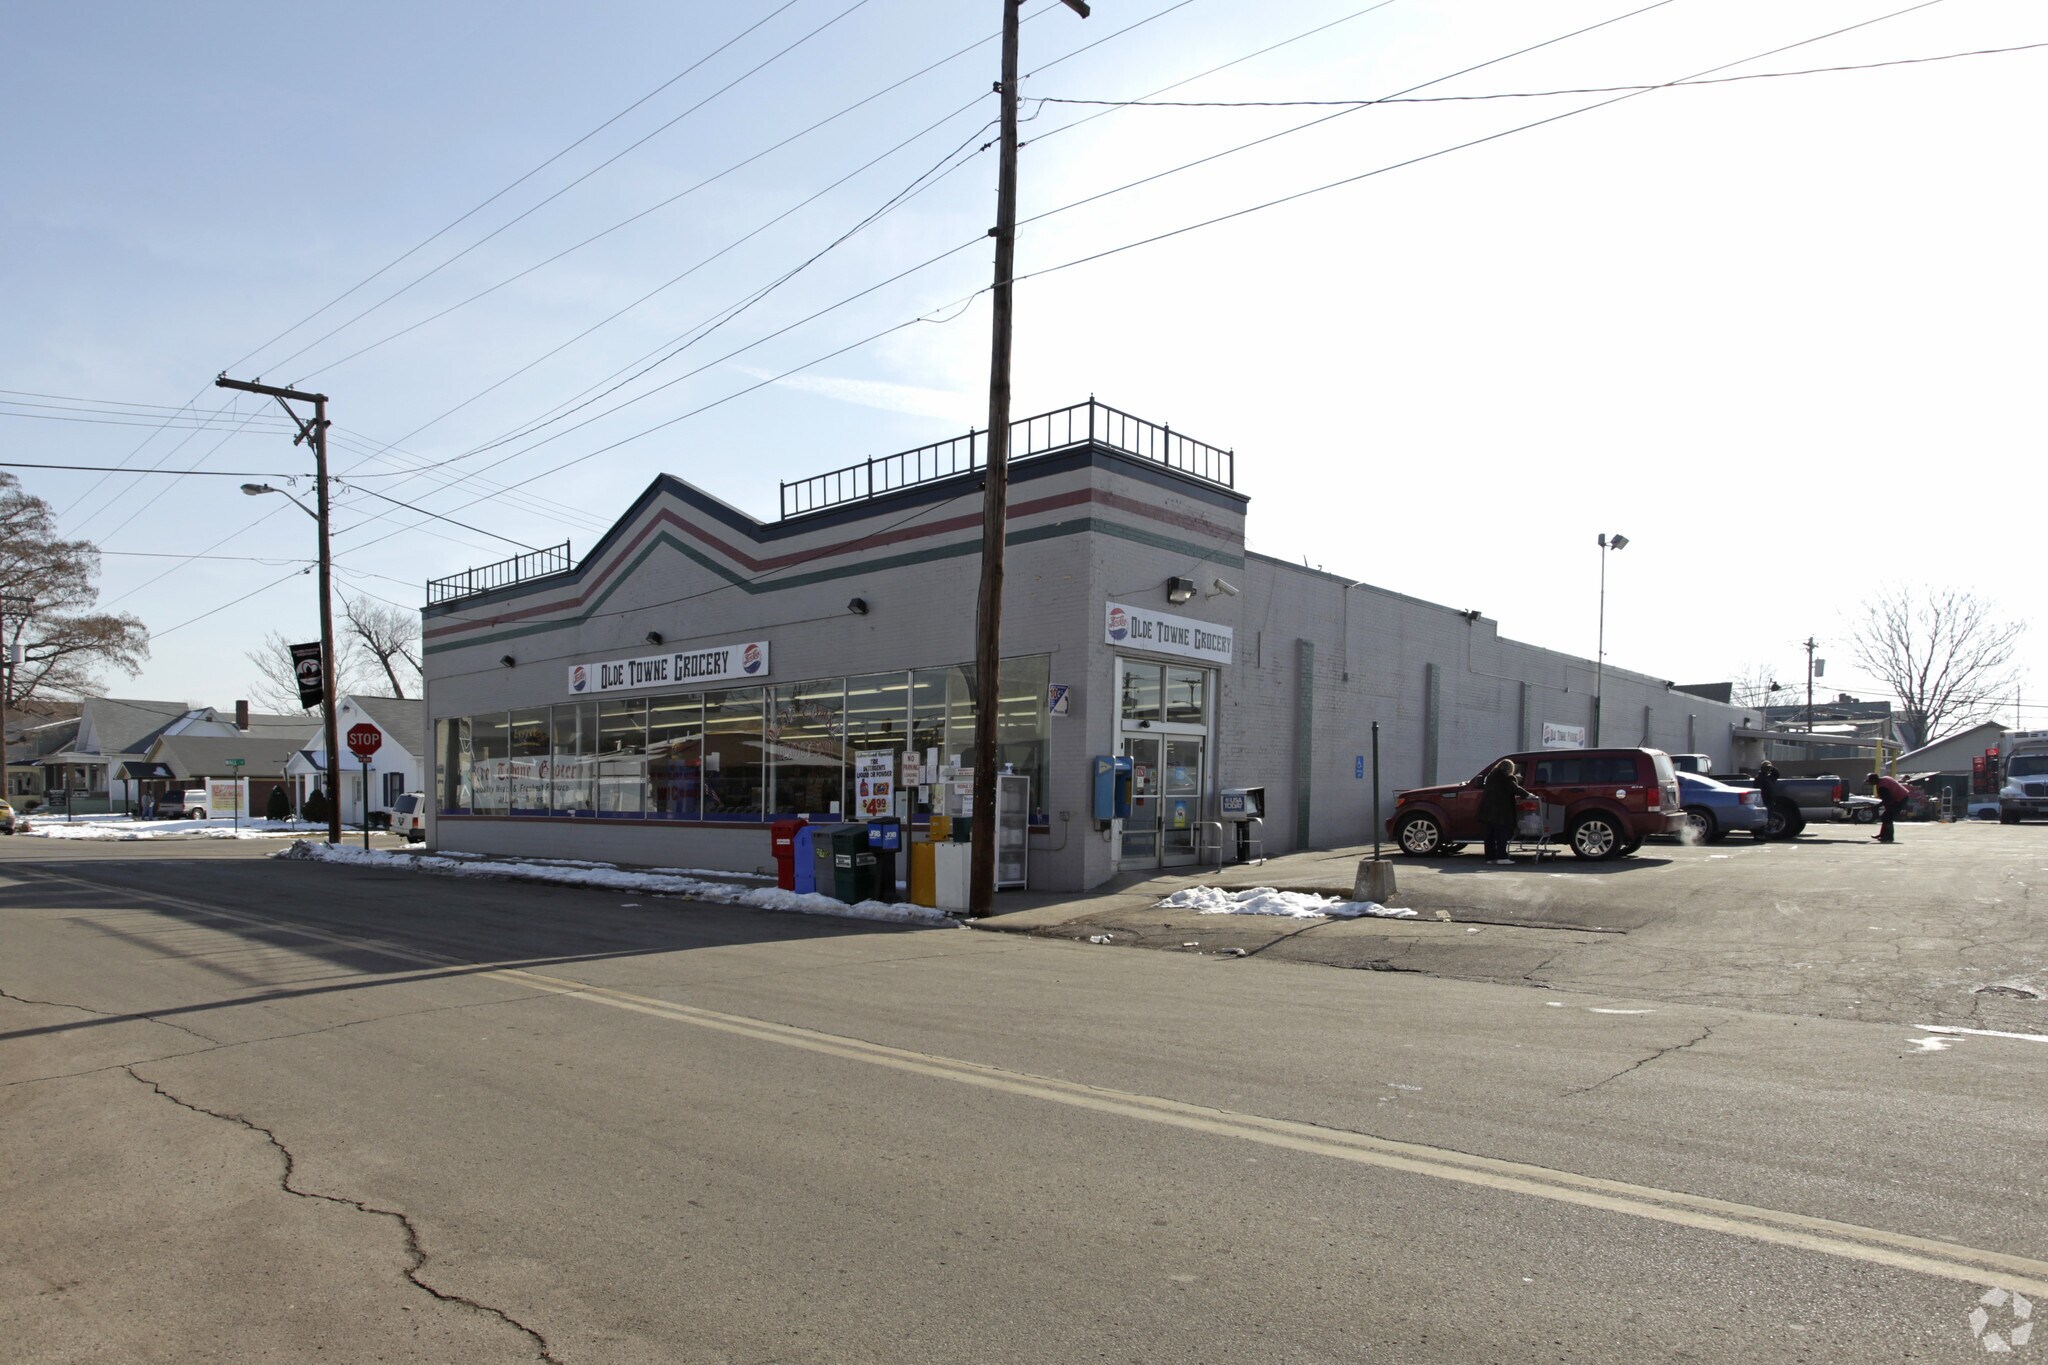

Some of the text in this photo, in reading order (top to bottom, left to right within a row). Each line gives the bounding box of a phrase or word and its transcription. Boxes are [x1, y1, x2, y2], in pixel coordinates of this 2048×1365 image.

[1131, 616, 1152, 639] OLDE
[1157, 622, 1189, 646] TOWNE
[1194, 628, 1232, 653] GROCERY
[601, 664, 624, 689] OLDE
[628, 659, 668, 686] TOWNE
[675, 650, 729, 681] GROCERY
[349, 733, 380, 745] STOP
